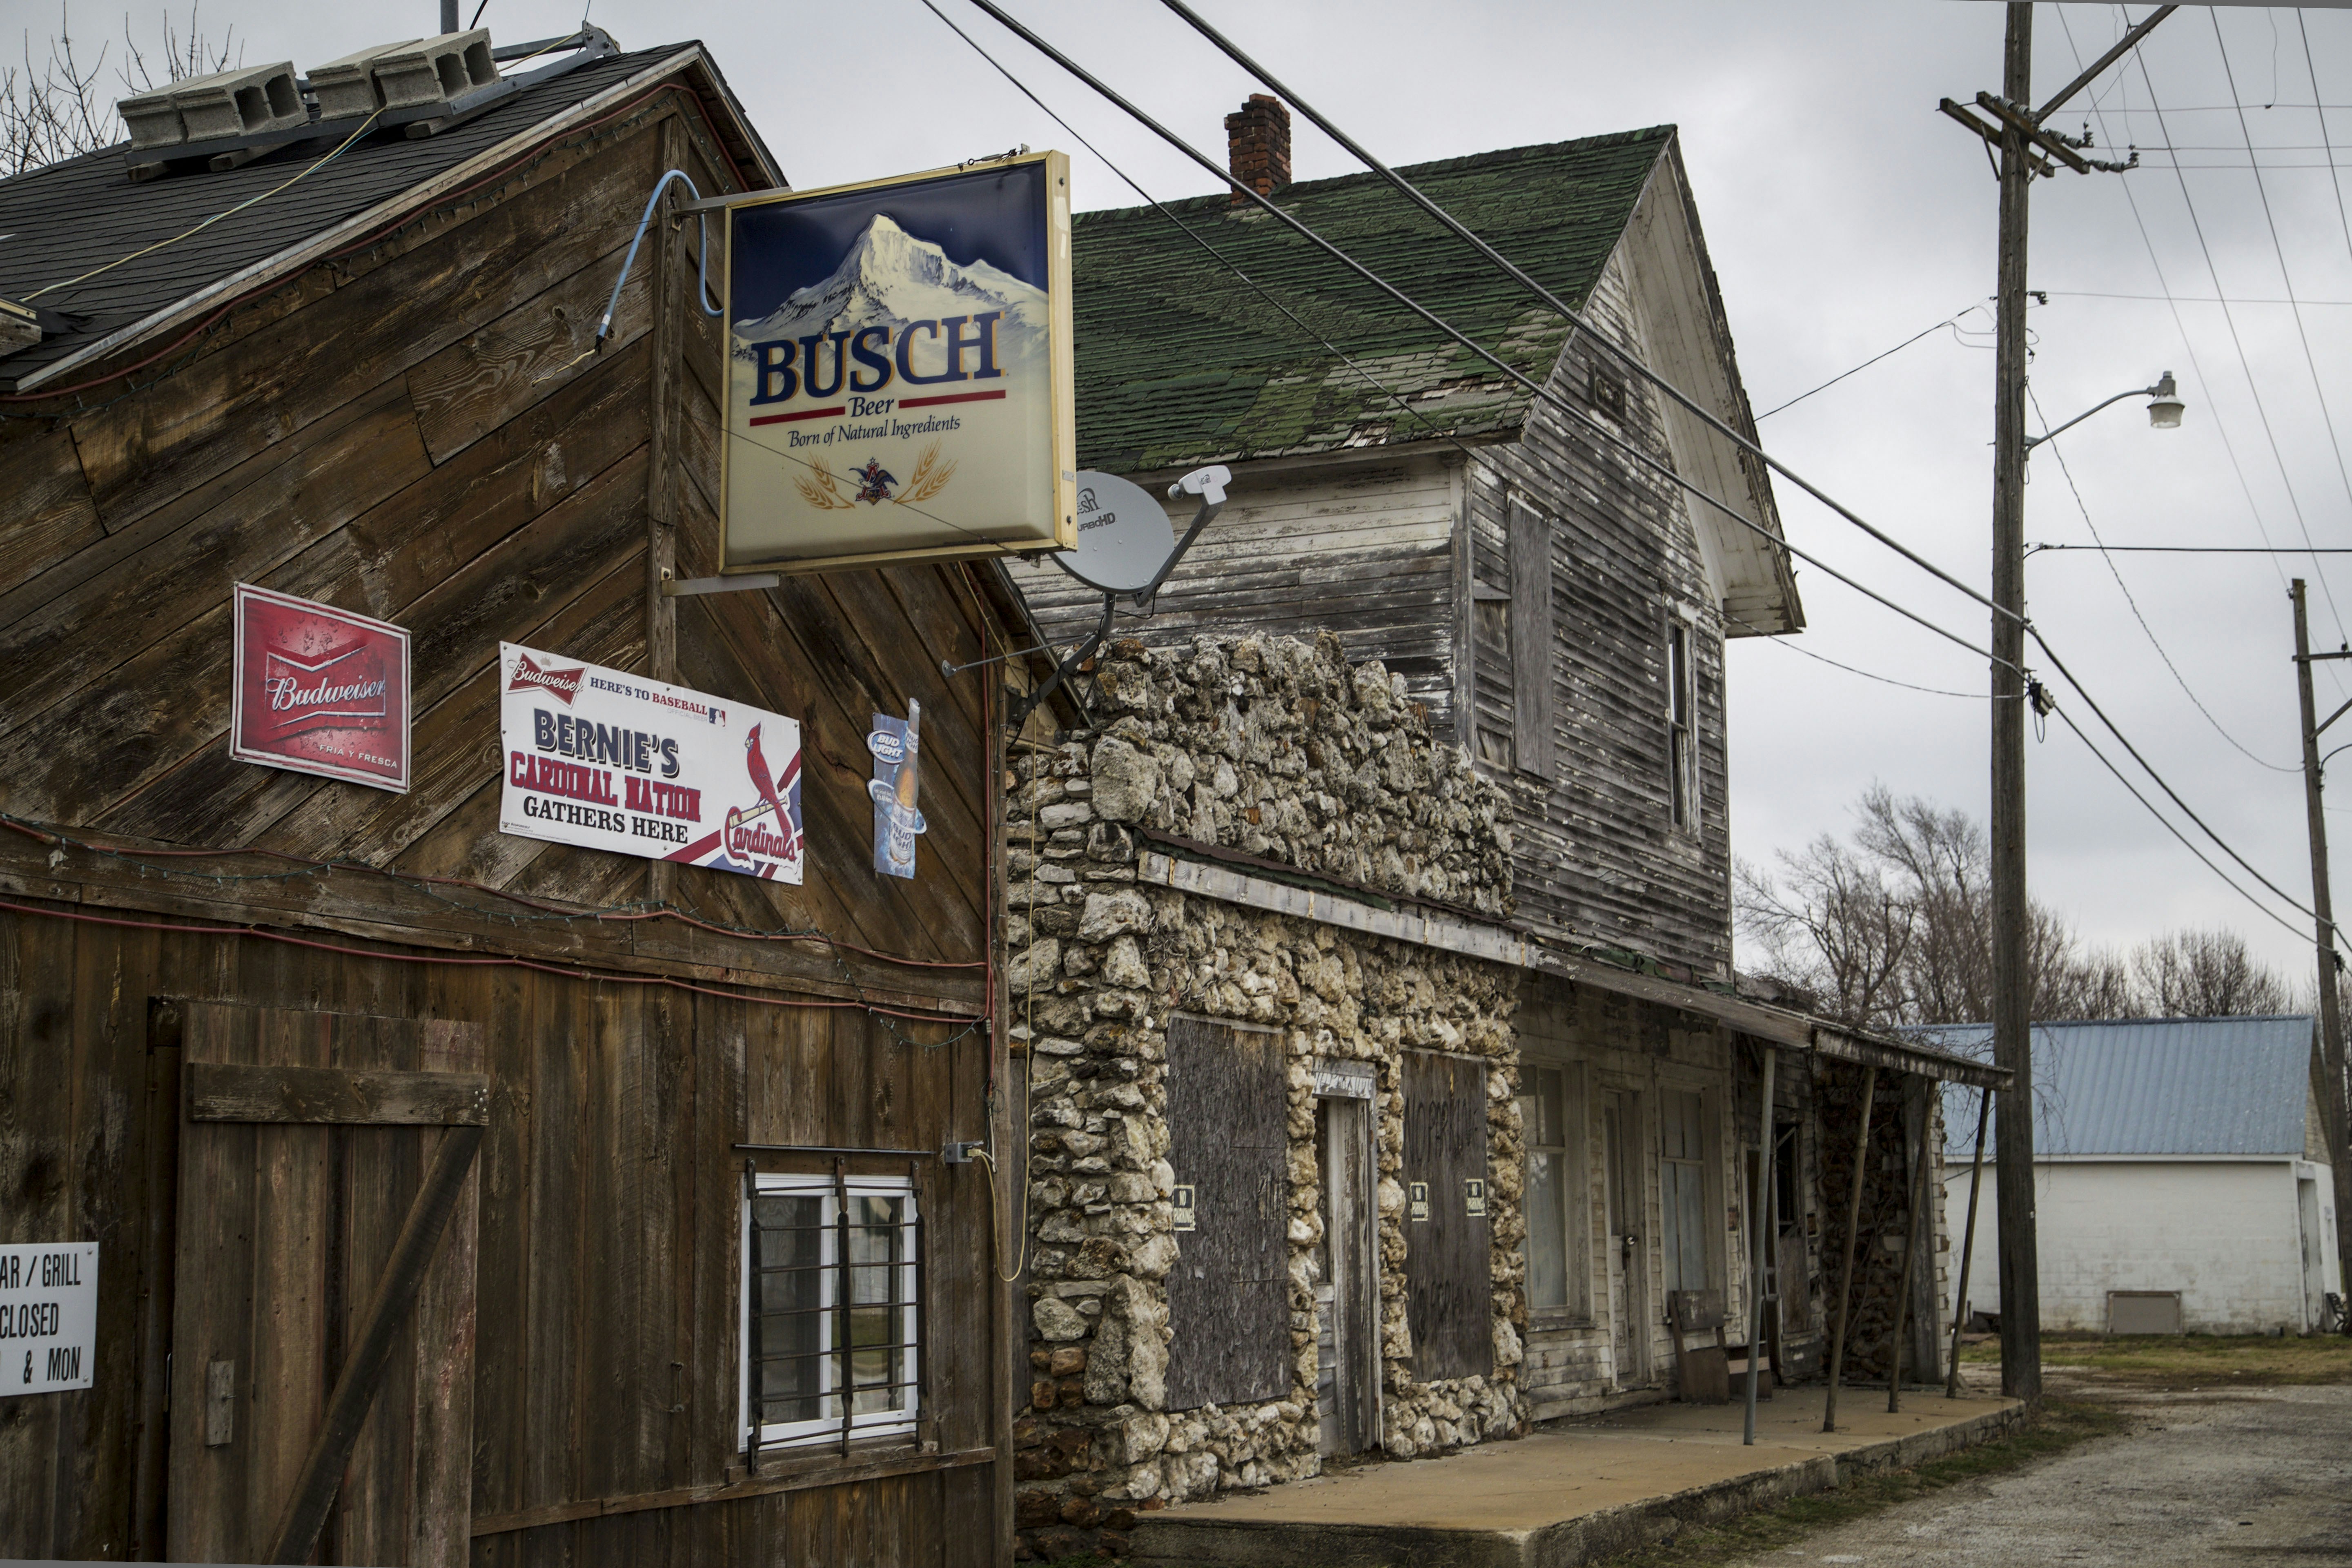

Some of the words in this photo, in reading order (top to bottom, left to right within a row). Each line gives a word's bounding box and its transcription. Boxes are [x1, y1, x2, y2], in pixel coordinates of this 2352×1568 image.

[750, 311, 1006, 405] BUSCH
[848, 396, 894, 418] Beer
[788, 428, 820, 448] Born
[823, 425, 836, 446] of
[838, 419, 889, 443] Natural
[891, 414, 960, 440] Ingredients
[1077, 512, 1116, 532] URBOHD
[266, 675, 386, 711] Budweiser
[507, 657, 585, 694] Budweiser
[590, 677, 632, 697] HERE'S
[635, 687, 650, 701] TO
[652, 693, 708, 715] BASEBALL
[666, 708, 693, 719] OFFICIAL
[319, 744, 344, 757] FRIA
[349, 750, 356, 759] Y
[358, 753, 398, 768] FRESCA
[533, 706, 680, 778] BERNIE'S
[873, 743, 903, 759] LIGHT
[877, 734, 900, 748] BUD
[510, 751, 618, 807] CARDINAL
[624, 775, 702, 823] NATION
[523, 796, 625, 833] GATHERS
[631, 816, 688, 844] HERE
[724, 805, 797, 862] Cardinals
[1179, 1190, 1187, 1206] NO
[0, 1255, 20, 1289] AR
[42, 1253, 81, 1287] GRILL
[0, 1303, 59, 1339] CLOSED
[23, 1350, 33, 1384] &
[47, 1346, 81, 1381] MON
